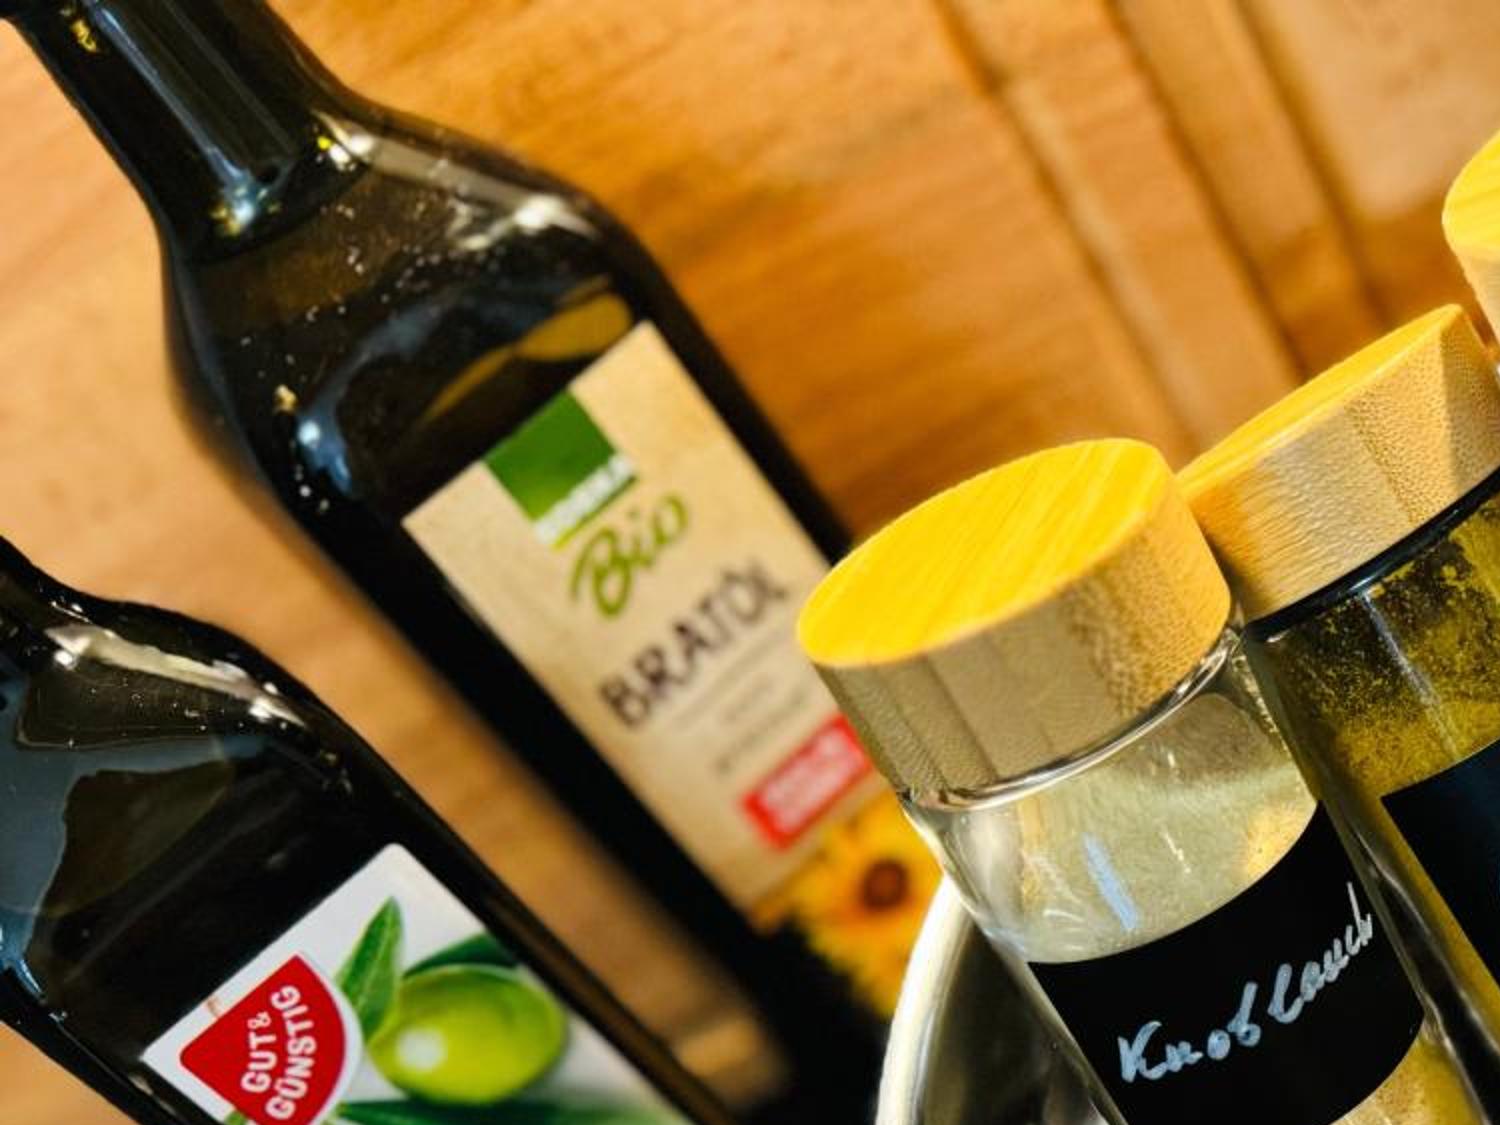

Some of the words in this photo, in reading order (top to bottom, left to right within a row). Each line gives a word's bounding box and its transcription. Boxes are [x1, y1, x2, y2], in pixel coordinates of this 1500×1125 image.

[569, 493, 689, 618] Bio
[1117, 881, 1374, 1083] Knoblauch
[264, 985, 318, 1121] GÜNSTIG
